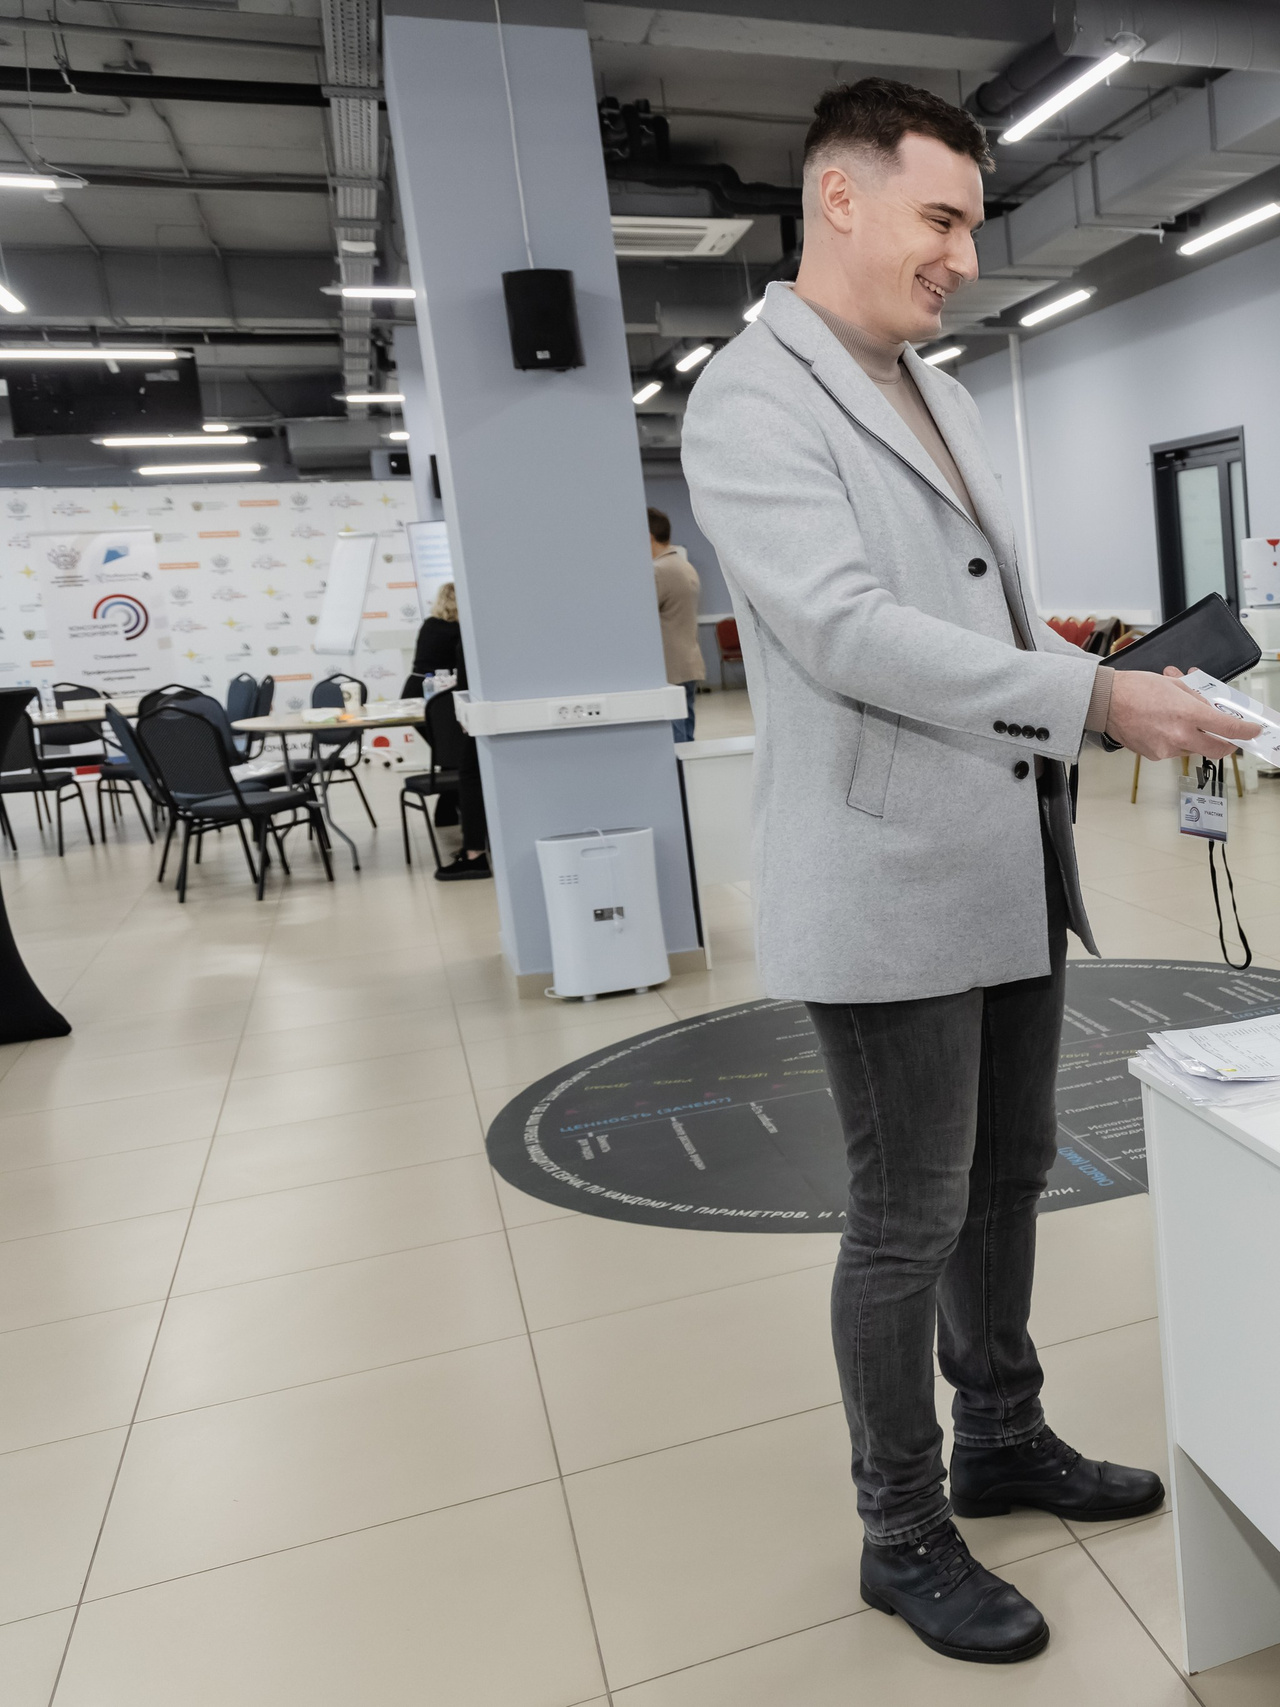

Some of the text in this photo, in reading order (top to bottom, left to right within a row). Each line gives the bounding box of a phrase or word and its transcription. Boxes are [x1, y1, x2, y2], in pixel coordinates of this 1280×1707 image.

[560, 1097, 731, 1132] ЦЕННОСТЬ (ЗАЧЕМ?)
[1065, 1100, 1120, 1115] Понятная
[1088, 1115, 1144, 1130] Использо
[1095, 1122, 1141, 1135] лучшей
[1102, 1128, 1145, 1140] зароди
[552, 1169, 591, 1190] СЕЙЧАС
[584, 1185, 606, 1194] ПО
[602, 1191, 671, 1208] КАЖДОМУ
[669, 1203, 693, 1212] ИЗ
[693, 1206, 810, 1219] ПАРАМЕТРОВ,
[818, 1211, 832, 1219] И
